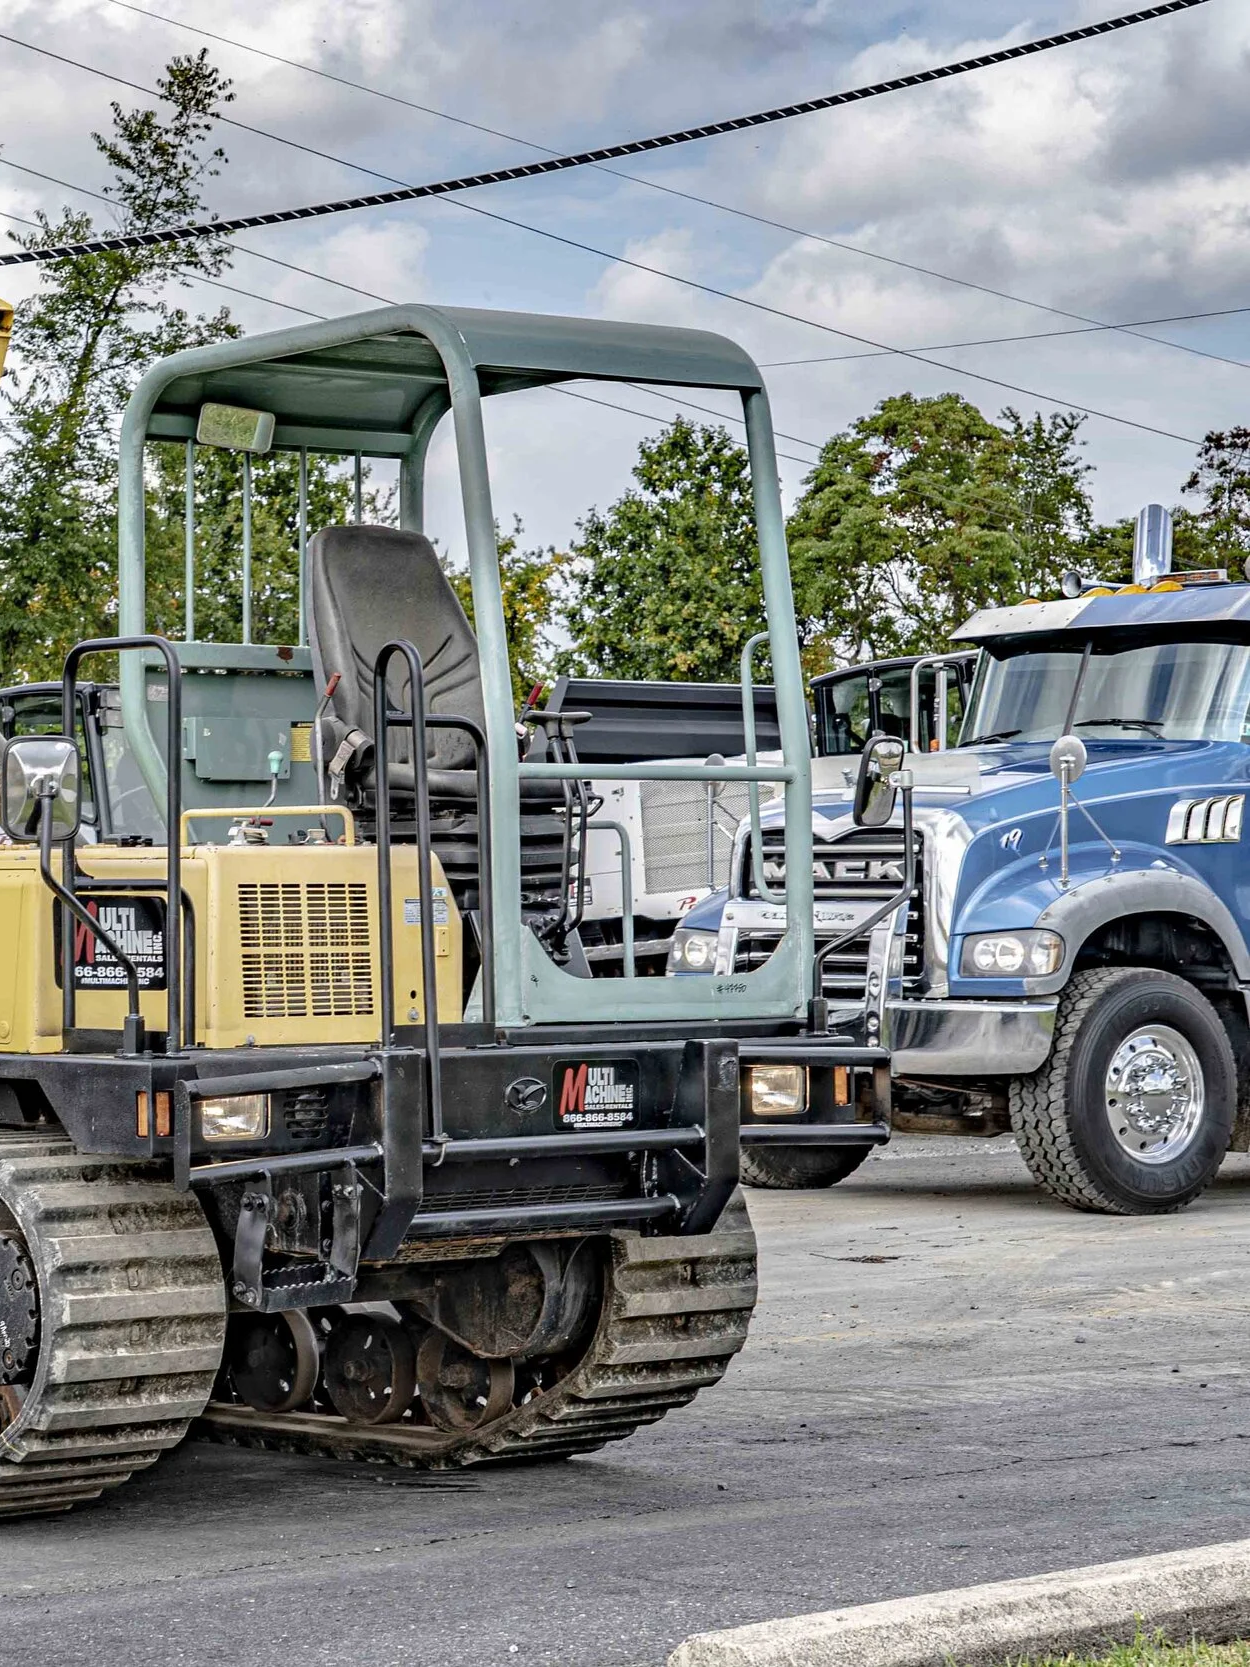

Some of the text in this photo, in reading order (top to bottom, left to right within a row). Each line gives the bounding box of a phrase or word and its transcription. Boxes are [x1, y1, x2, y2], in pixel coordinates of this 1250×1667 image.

[1000, 828, 1022, 850] 19
[152, 931, 163, 954] INC.
[75, 966, 164, 978] 66-866-584
[563, 1112, 634, 1123] 866-866-8584
